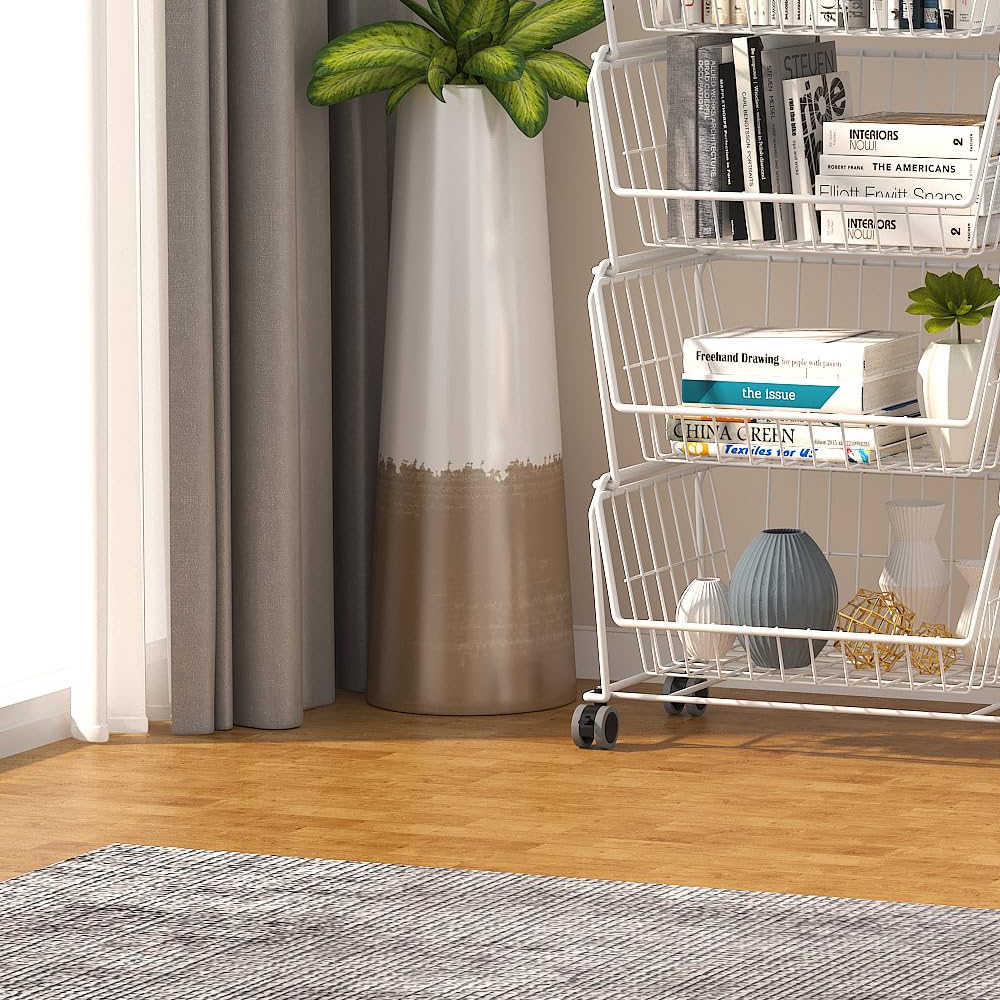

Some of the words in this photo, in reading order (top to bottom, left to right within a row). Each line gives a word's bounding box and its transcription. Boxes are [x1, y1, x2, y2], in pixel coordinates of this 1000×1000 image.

[766, 65, 774, 92] STEVEN
[850, 129, 898, 140] INTERIORS
[850, 140, 877, 151] NOW!
[953, 138, 962, 146] 2
[742, 110, 750, 149] BENGTSSON
[746, 151, 754, 187] PORTRAITS
[872, 163, 891, 171] THE
[896, 163, 956, 173] AMERICANS
[848, 219, 896, 230] INTERIORS
[848, 229, 874, 240] NOW!
[951, 227, 960, 235] 2
[696, 351, 738, 363] Freehand
[742, 353, 779, 366] Drawing
[809, 359, 821, 367] with
[742, 387, 762, 399] the
[765, 388, 796, 401] issue
[674, 424, 731, 441] CHINA
[737, 425, 794, 444] GREEN
